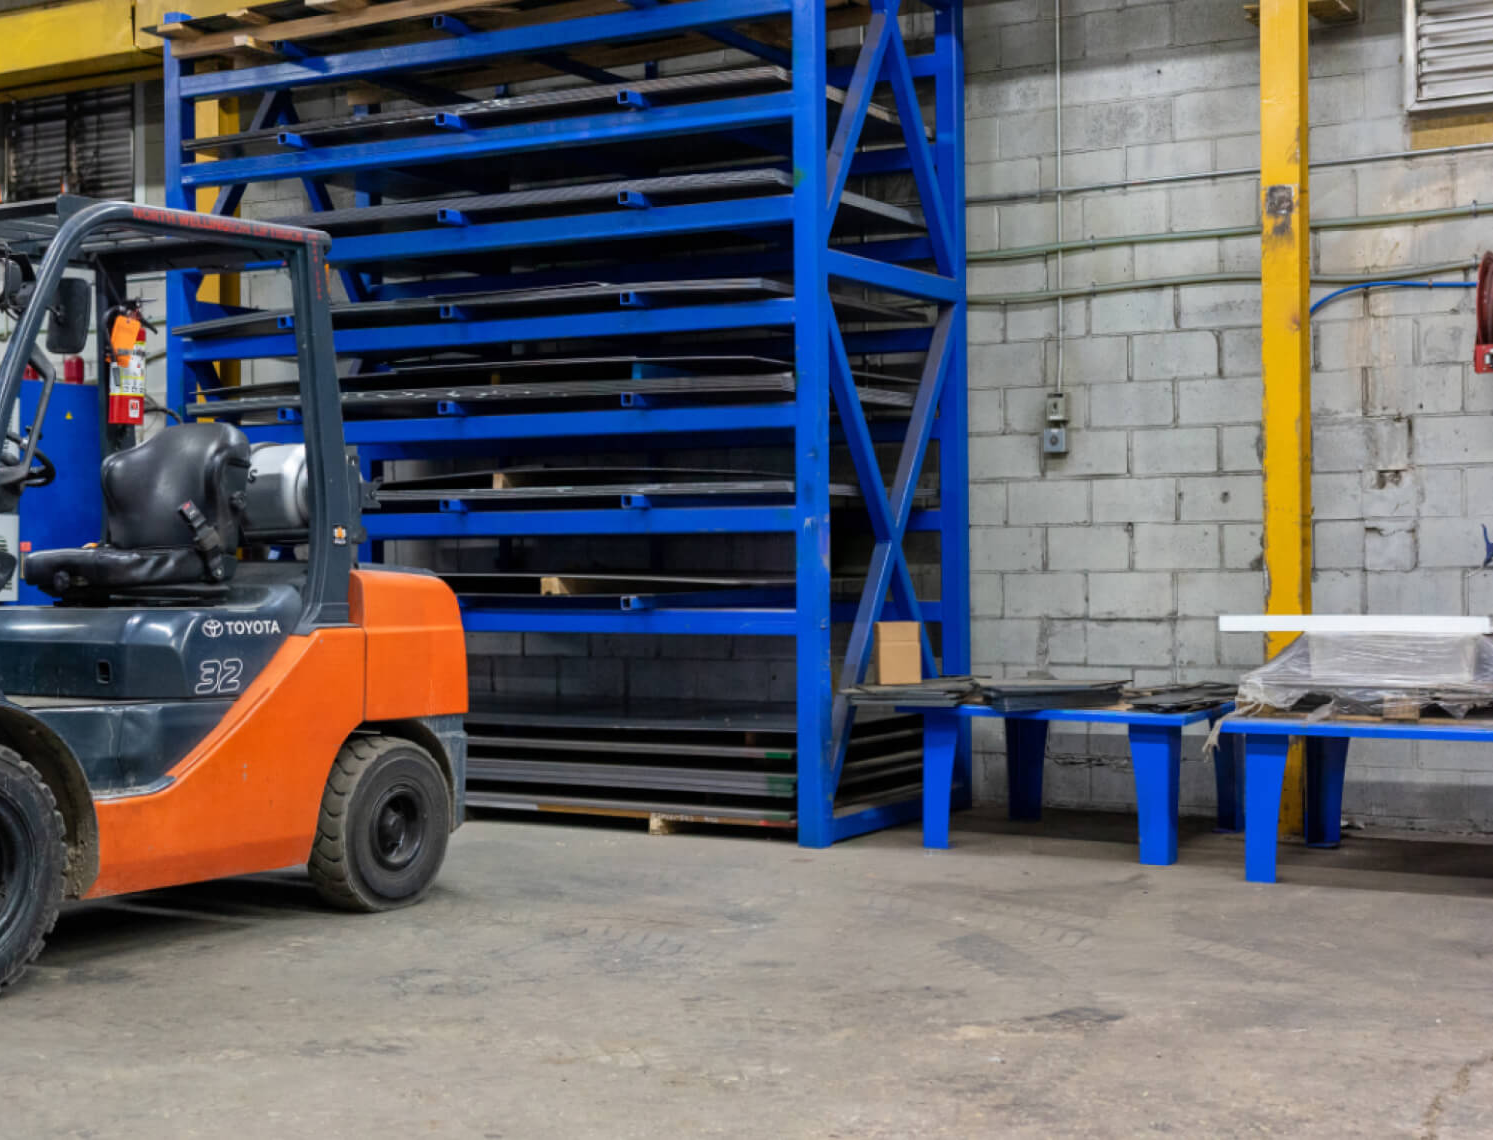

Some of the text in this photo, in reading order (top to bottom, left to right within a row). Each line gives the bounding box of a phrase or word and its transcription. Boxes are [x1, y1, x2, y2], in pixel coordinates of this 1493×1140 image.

[132, 207, 178, 226] NORTH
[225, 620, 281, 634] TOYOTA
[195, 658, 243, 694] 32
